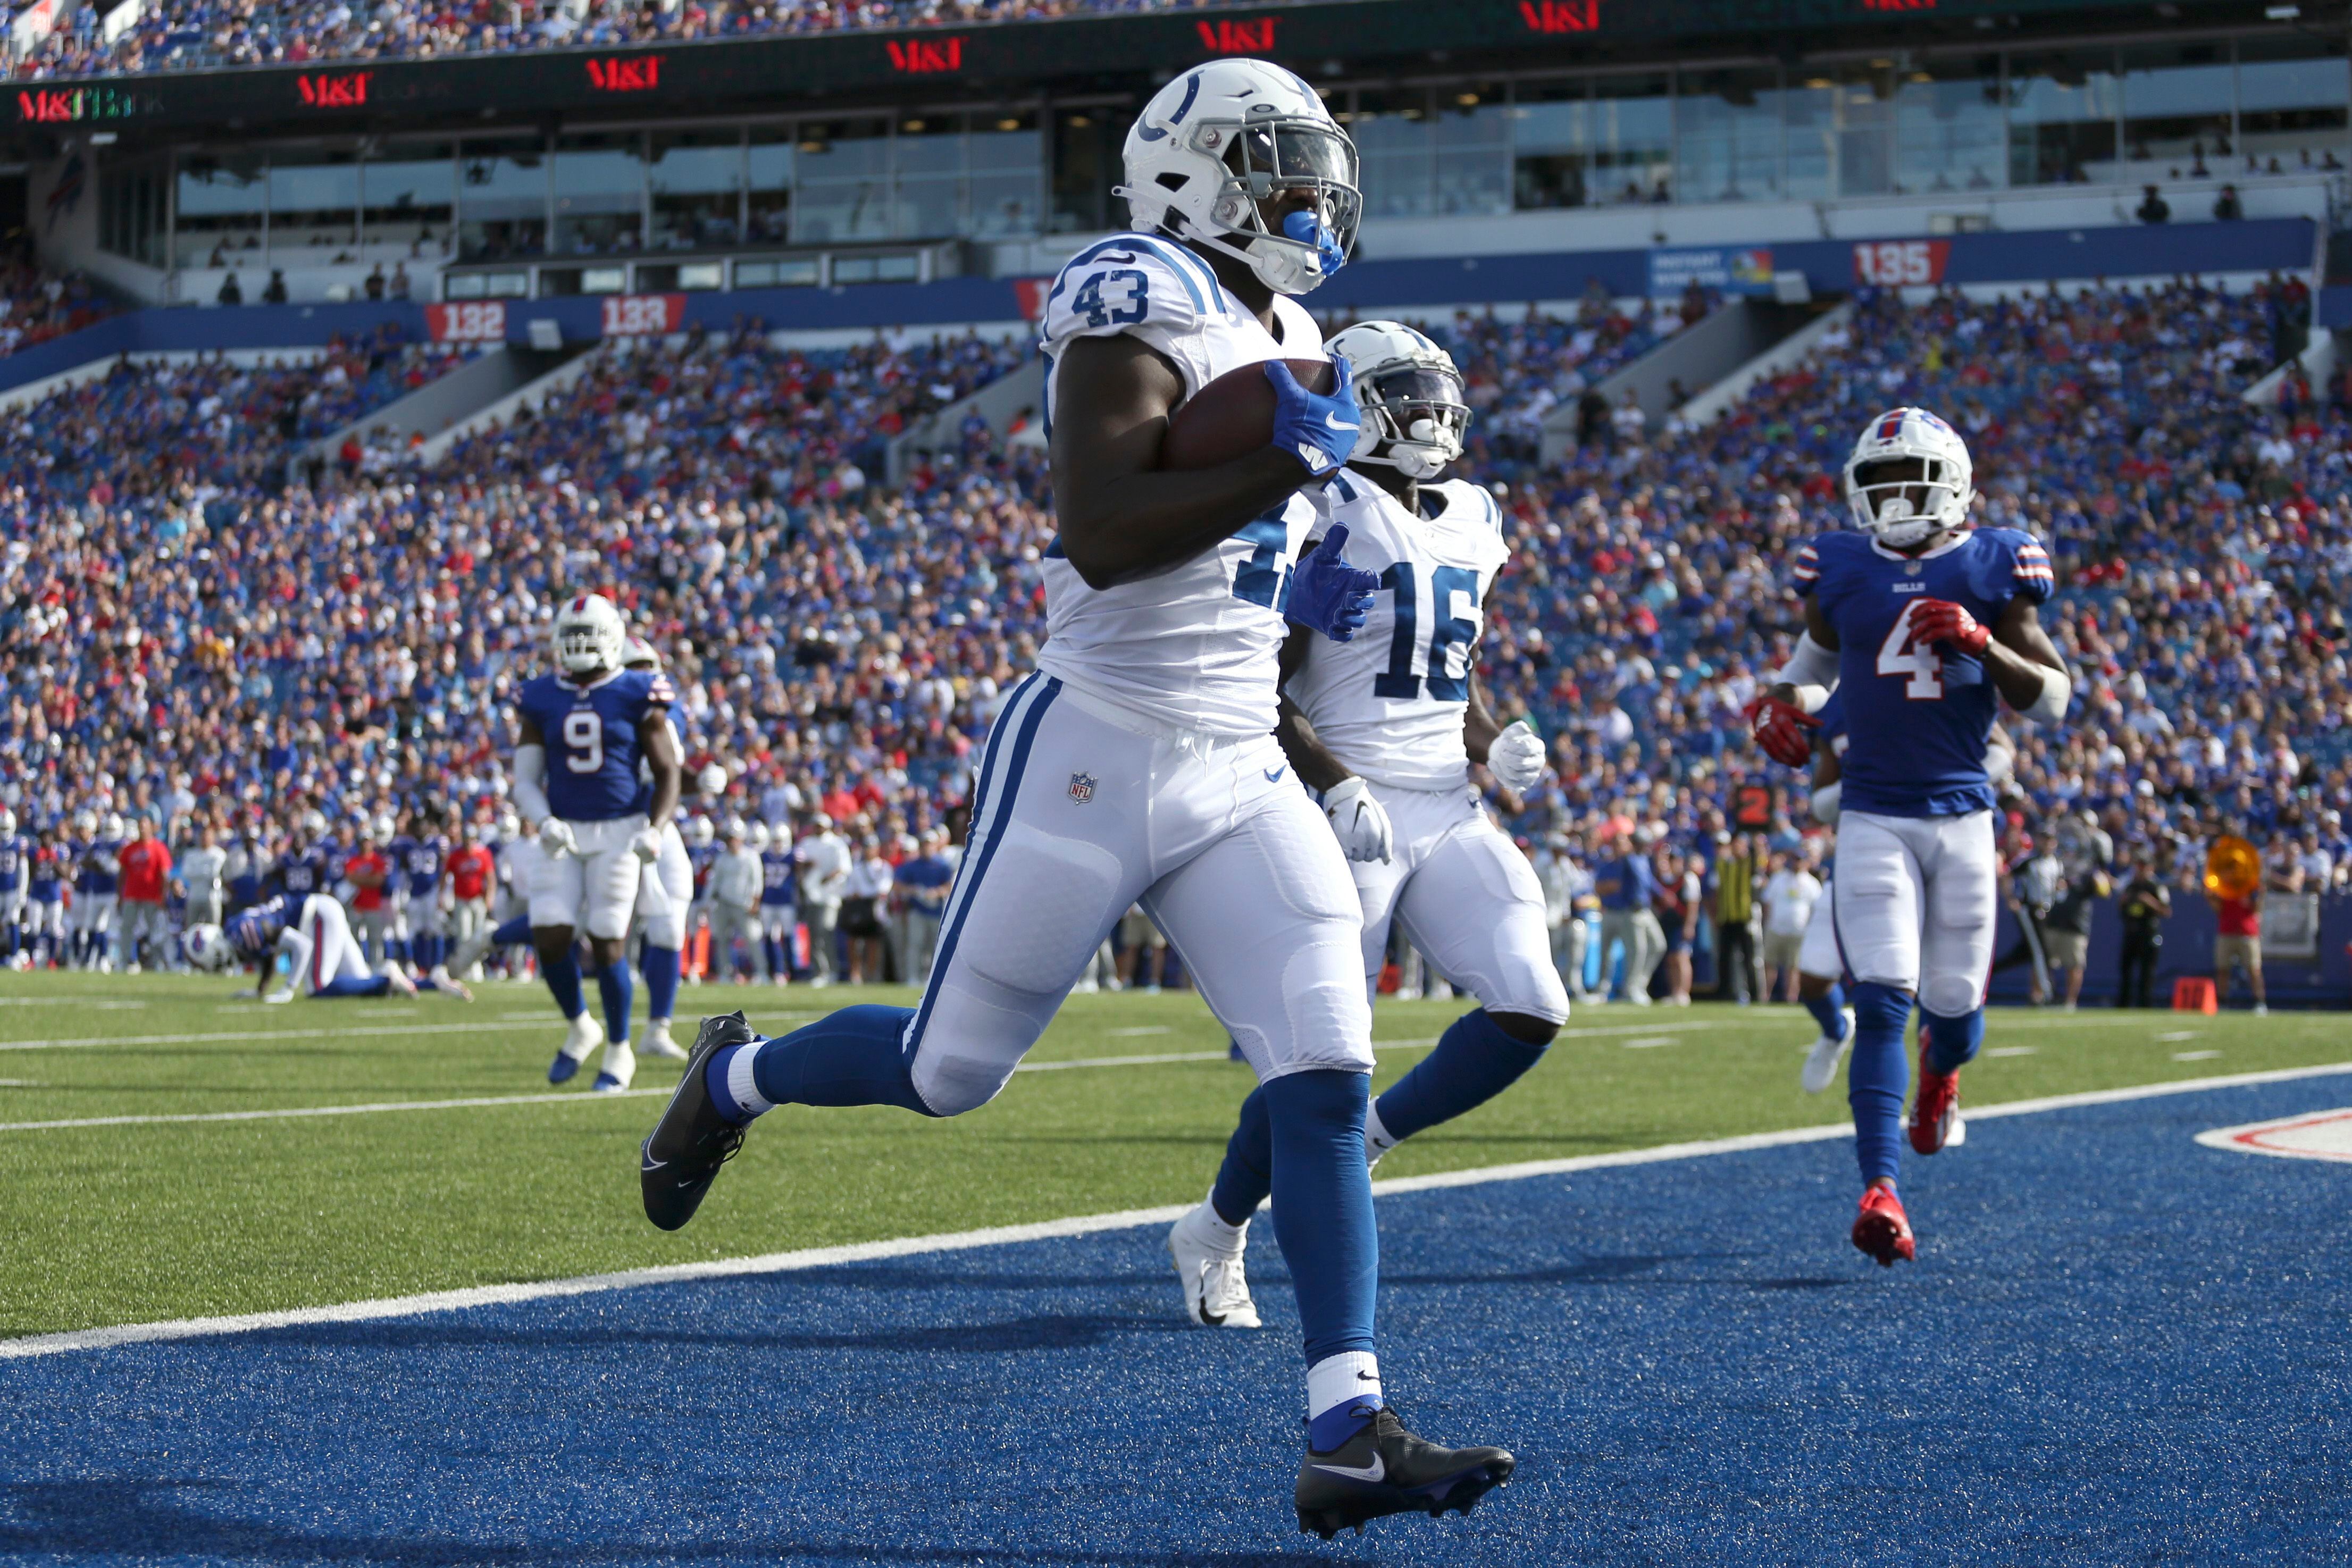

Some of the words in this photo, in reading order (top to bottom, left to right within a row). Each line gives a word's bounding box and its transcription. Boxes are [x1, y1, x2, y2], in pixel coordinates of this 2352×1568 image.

[1195, 16, 1283, 53] M&T
[585, 55, 666, 92] M&T
[885, 36, 969, 73] M&T
[297, 72, 373, 107] M&T
[1854, 242, 1931, 286] 135
[602, 295, 667, 334] 133
[1072, 269, 1149, 328] 43
[443, 302, 505, 340] 132
[1232, 499, 1295, 614] 4
[1374, 561, 1479, 702] 16
[1876, 597, 1945, 701] 4
[563, 711, 604, 774] 9
[1072, 783, 1090, 798] NFL
[1738, 787, 1770, 825] 2
